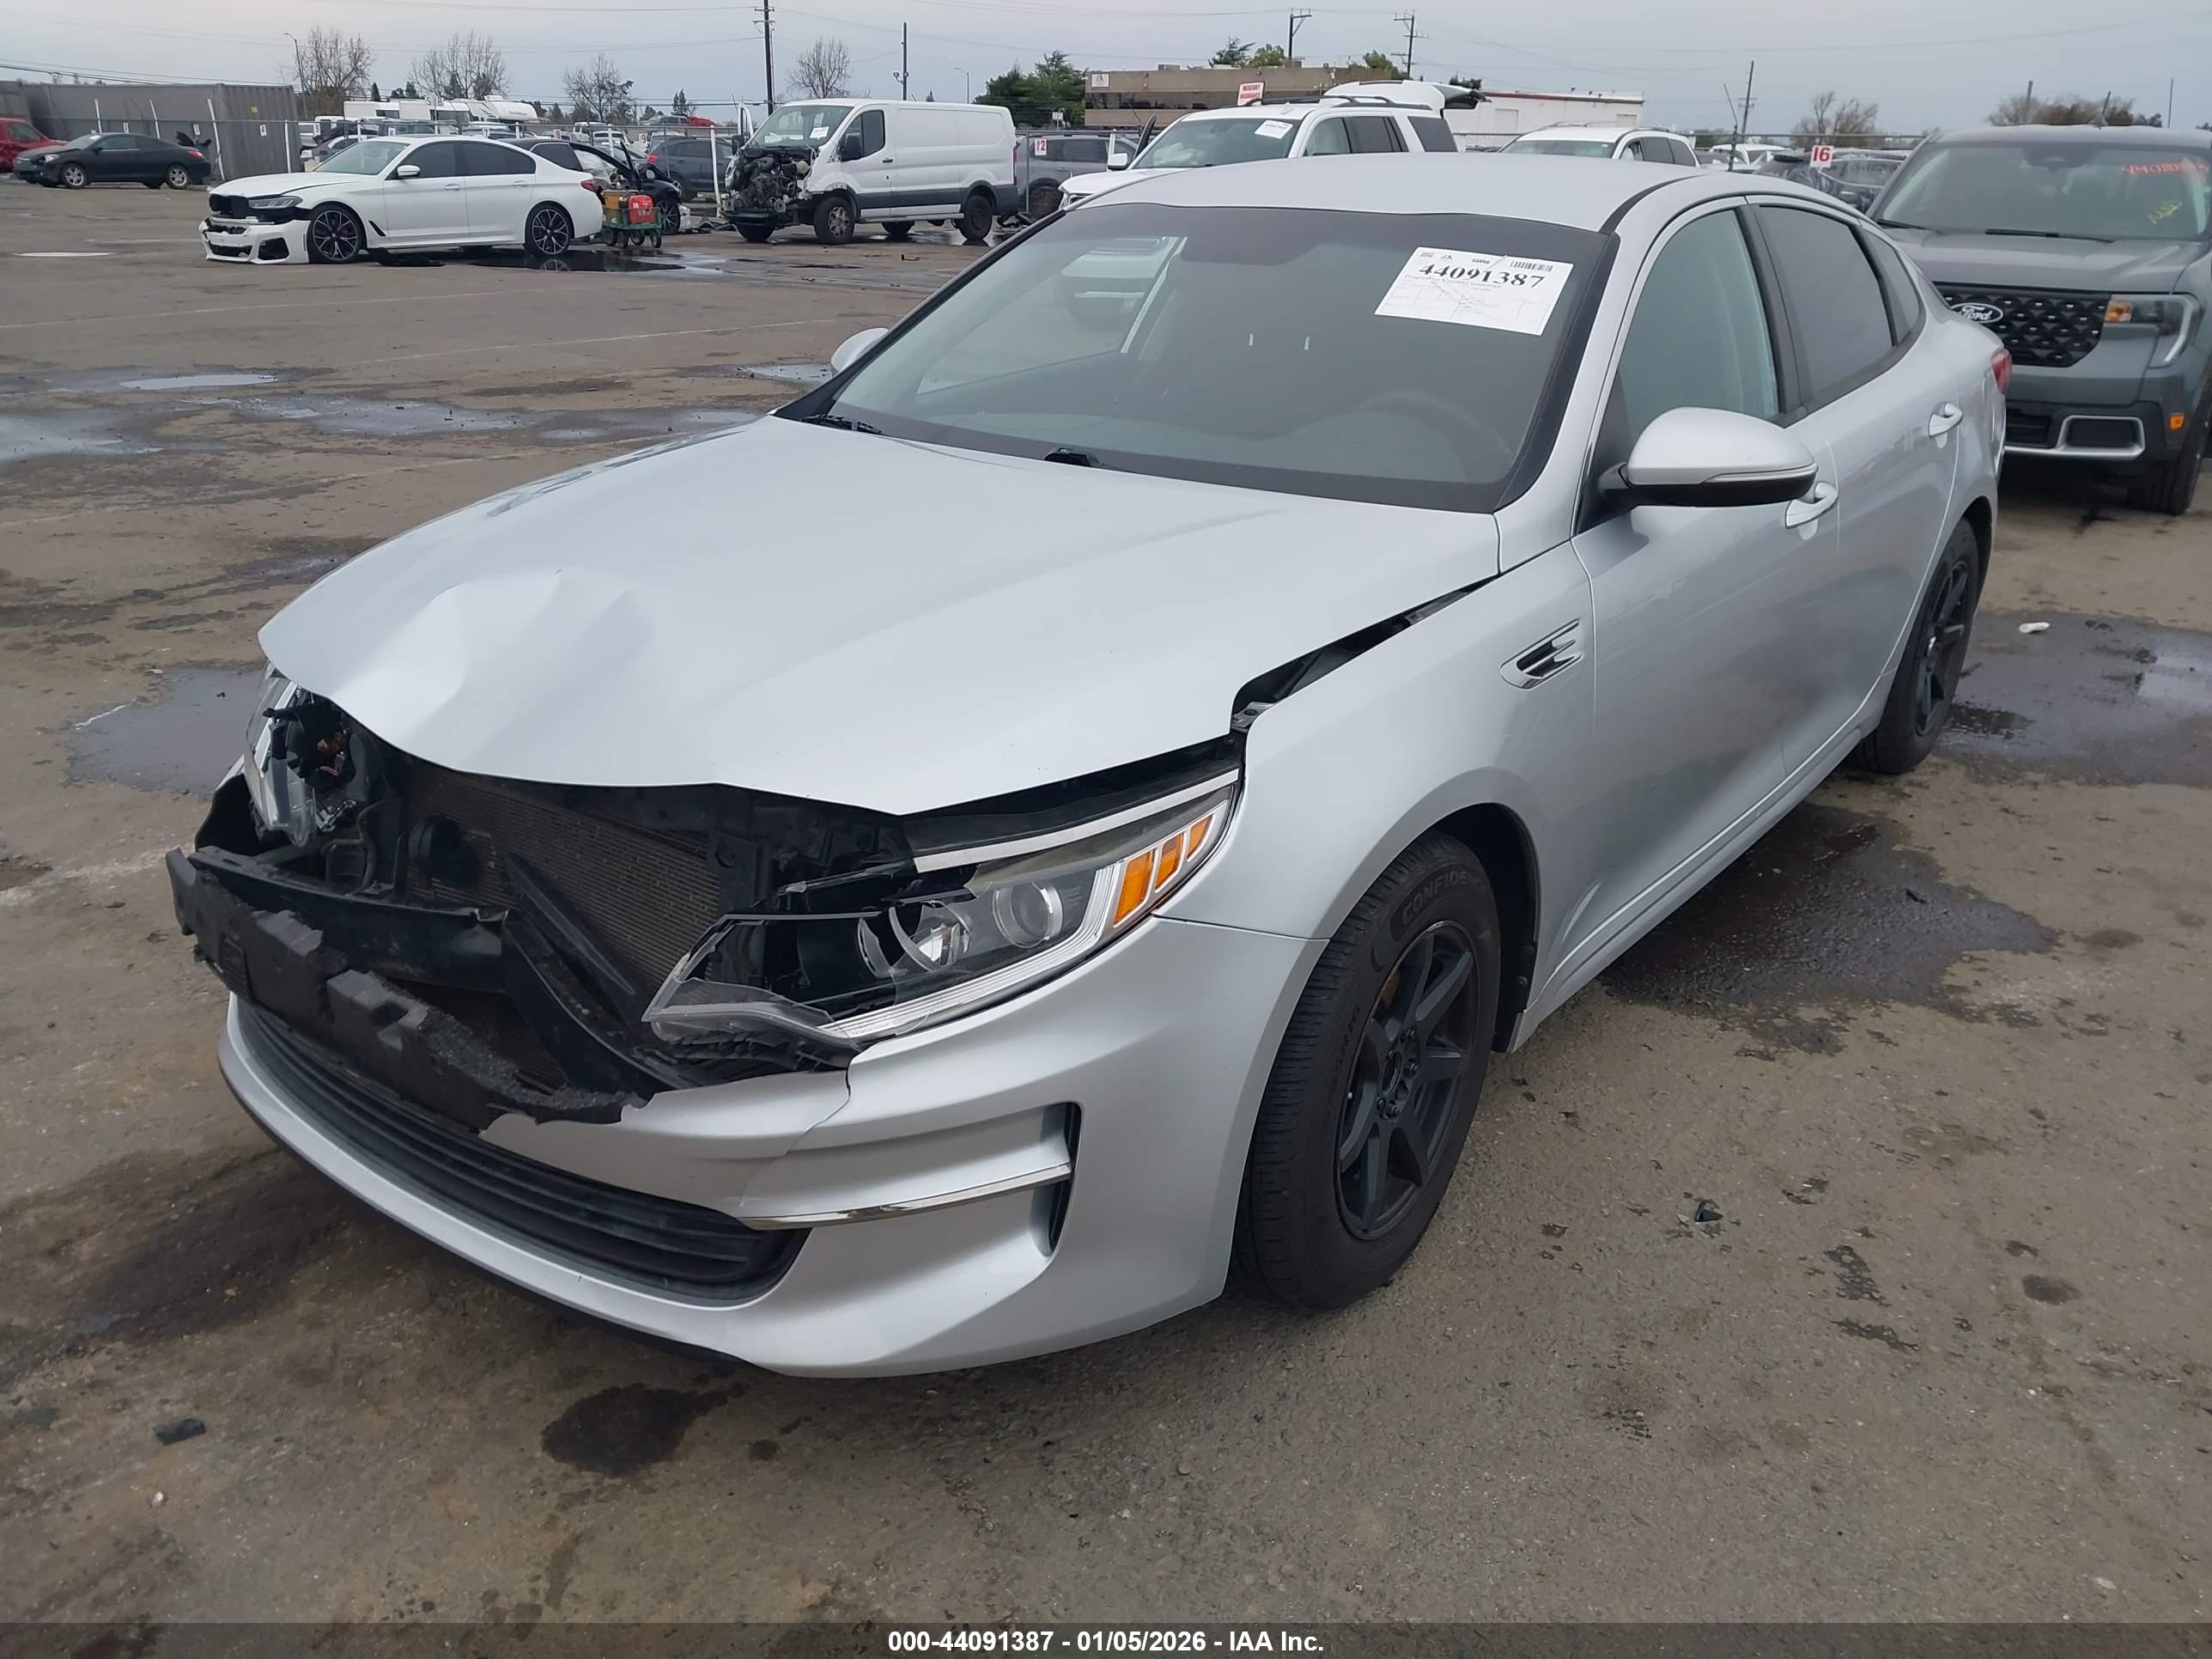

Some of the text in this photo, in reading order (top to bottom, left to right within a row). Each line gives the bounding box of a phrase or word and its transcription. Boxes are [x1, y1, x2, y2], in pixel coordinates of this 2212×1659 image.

[1036, 139, 1046, 151] 12
[1813, 146, 1831, 162] 16
[1419, 263, 1546, 289] 44091387
[1958, 305, 1993, 321] Ford
